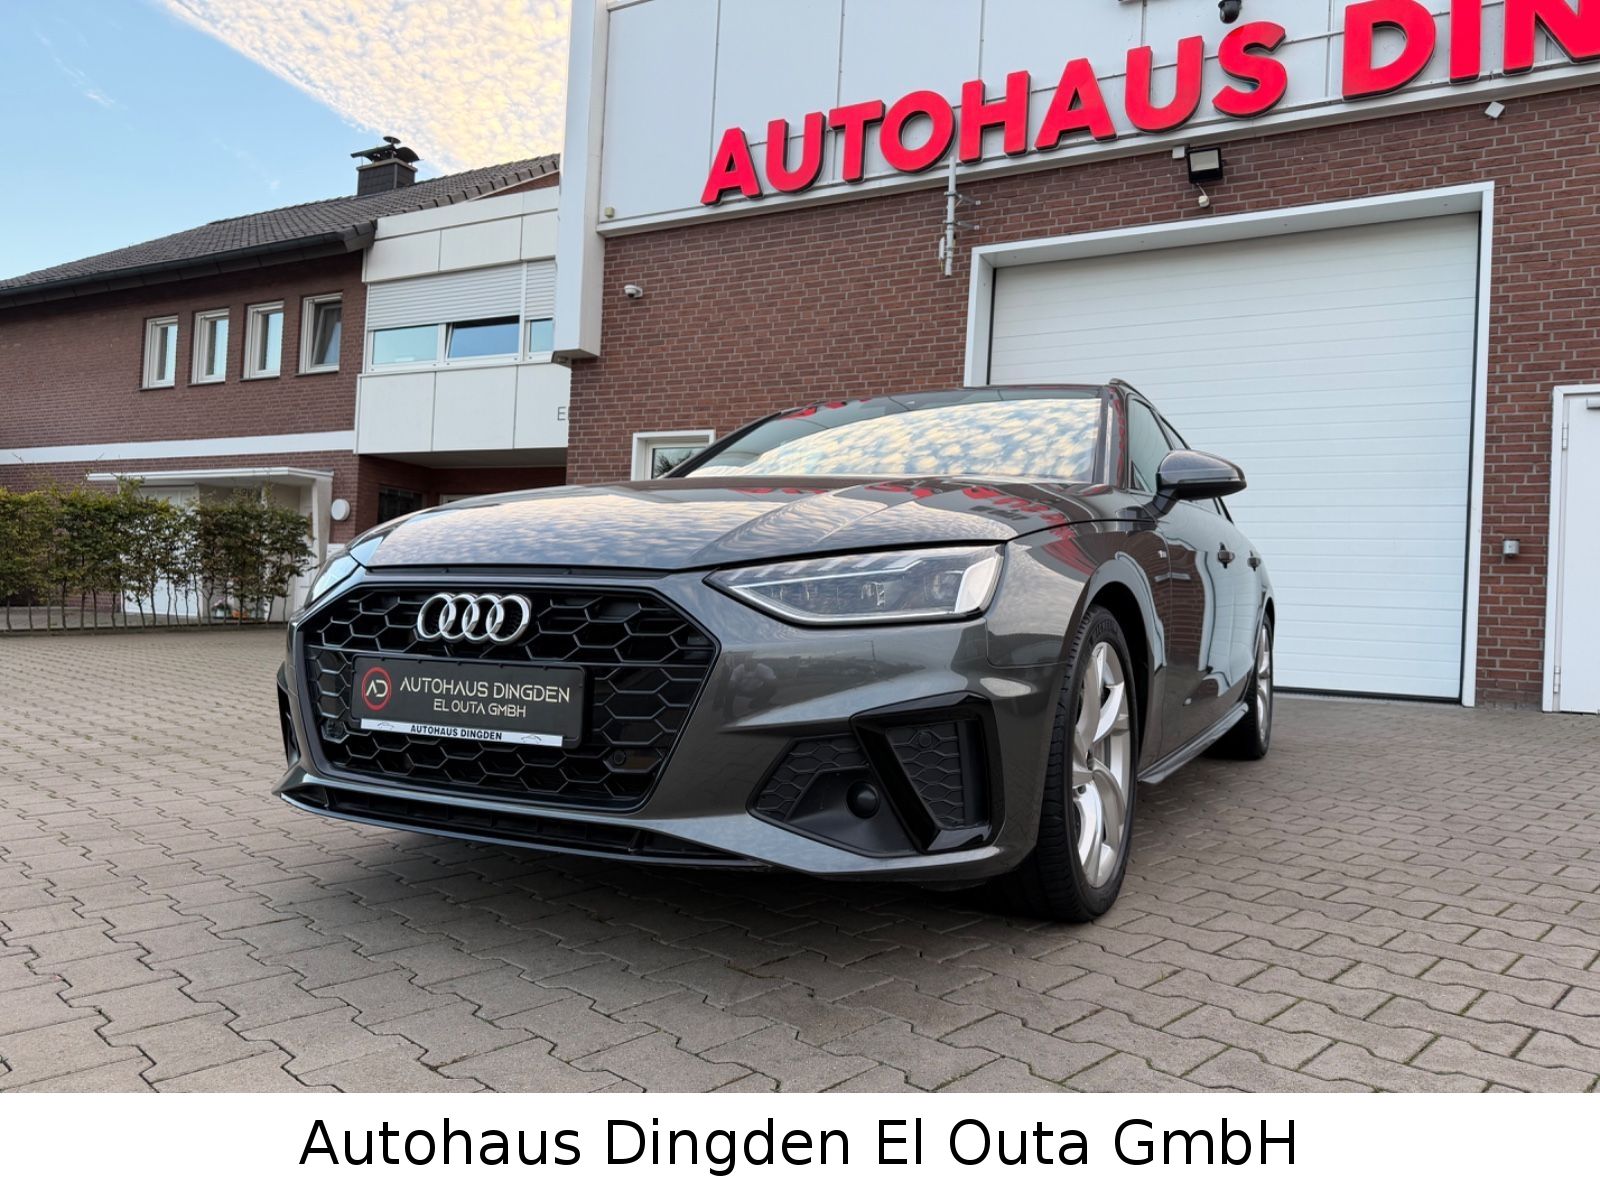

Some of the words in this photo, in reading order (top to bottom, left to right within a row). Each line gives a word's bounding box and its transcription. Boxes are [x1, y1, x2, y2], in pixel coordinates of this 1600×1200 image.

[702, 22, 1288, 205] AUTOHAUS
[400, 676, 489, 698] AUTOHAUS
[493, 682, 571, 703] DINGDEN
[433, 698, 450, 712] EL
[451, 699, 486, 715] OUTA
[488, 703, 527, 718] GMBH
[410, 724, 458, 737] AUTOHAUS
[460, 729, 502, 741] DINGDEN
